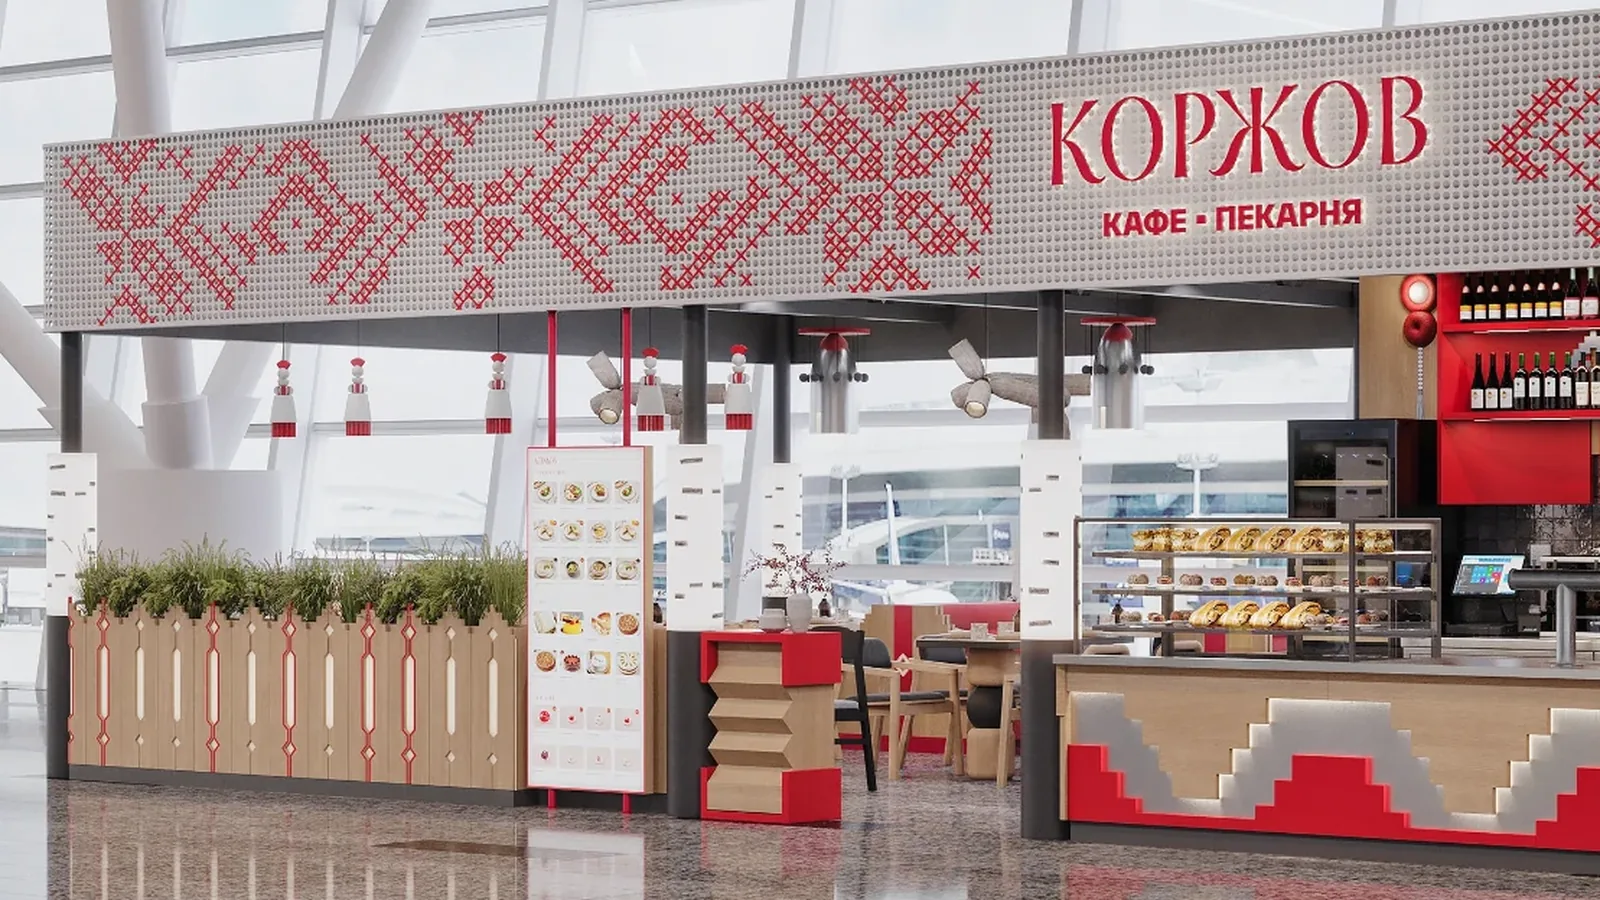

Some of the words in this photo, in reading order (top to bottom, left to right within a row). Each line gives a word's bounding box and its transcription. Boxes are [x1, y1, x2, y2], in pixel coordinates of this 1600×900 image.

[1050, 75, 1428, 186] КОРЖОВ
[1102, 208, 1188, 237] КАФЕ
[1215, 198, 1362, 232] ПЕКАРНЯ
